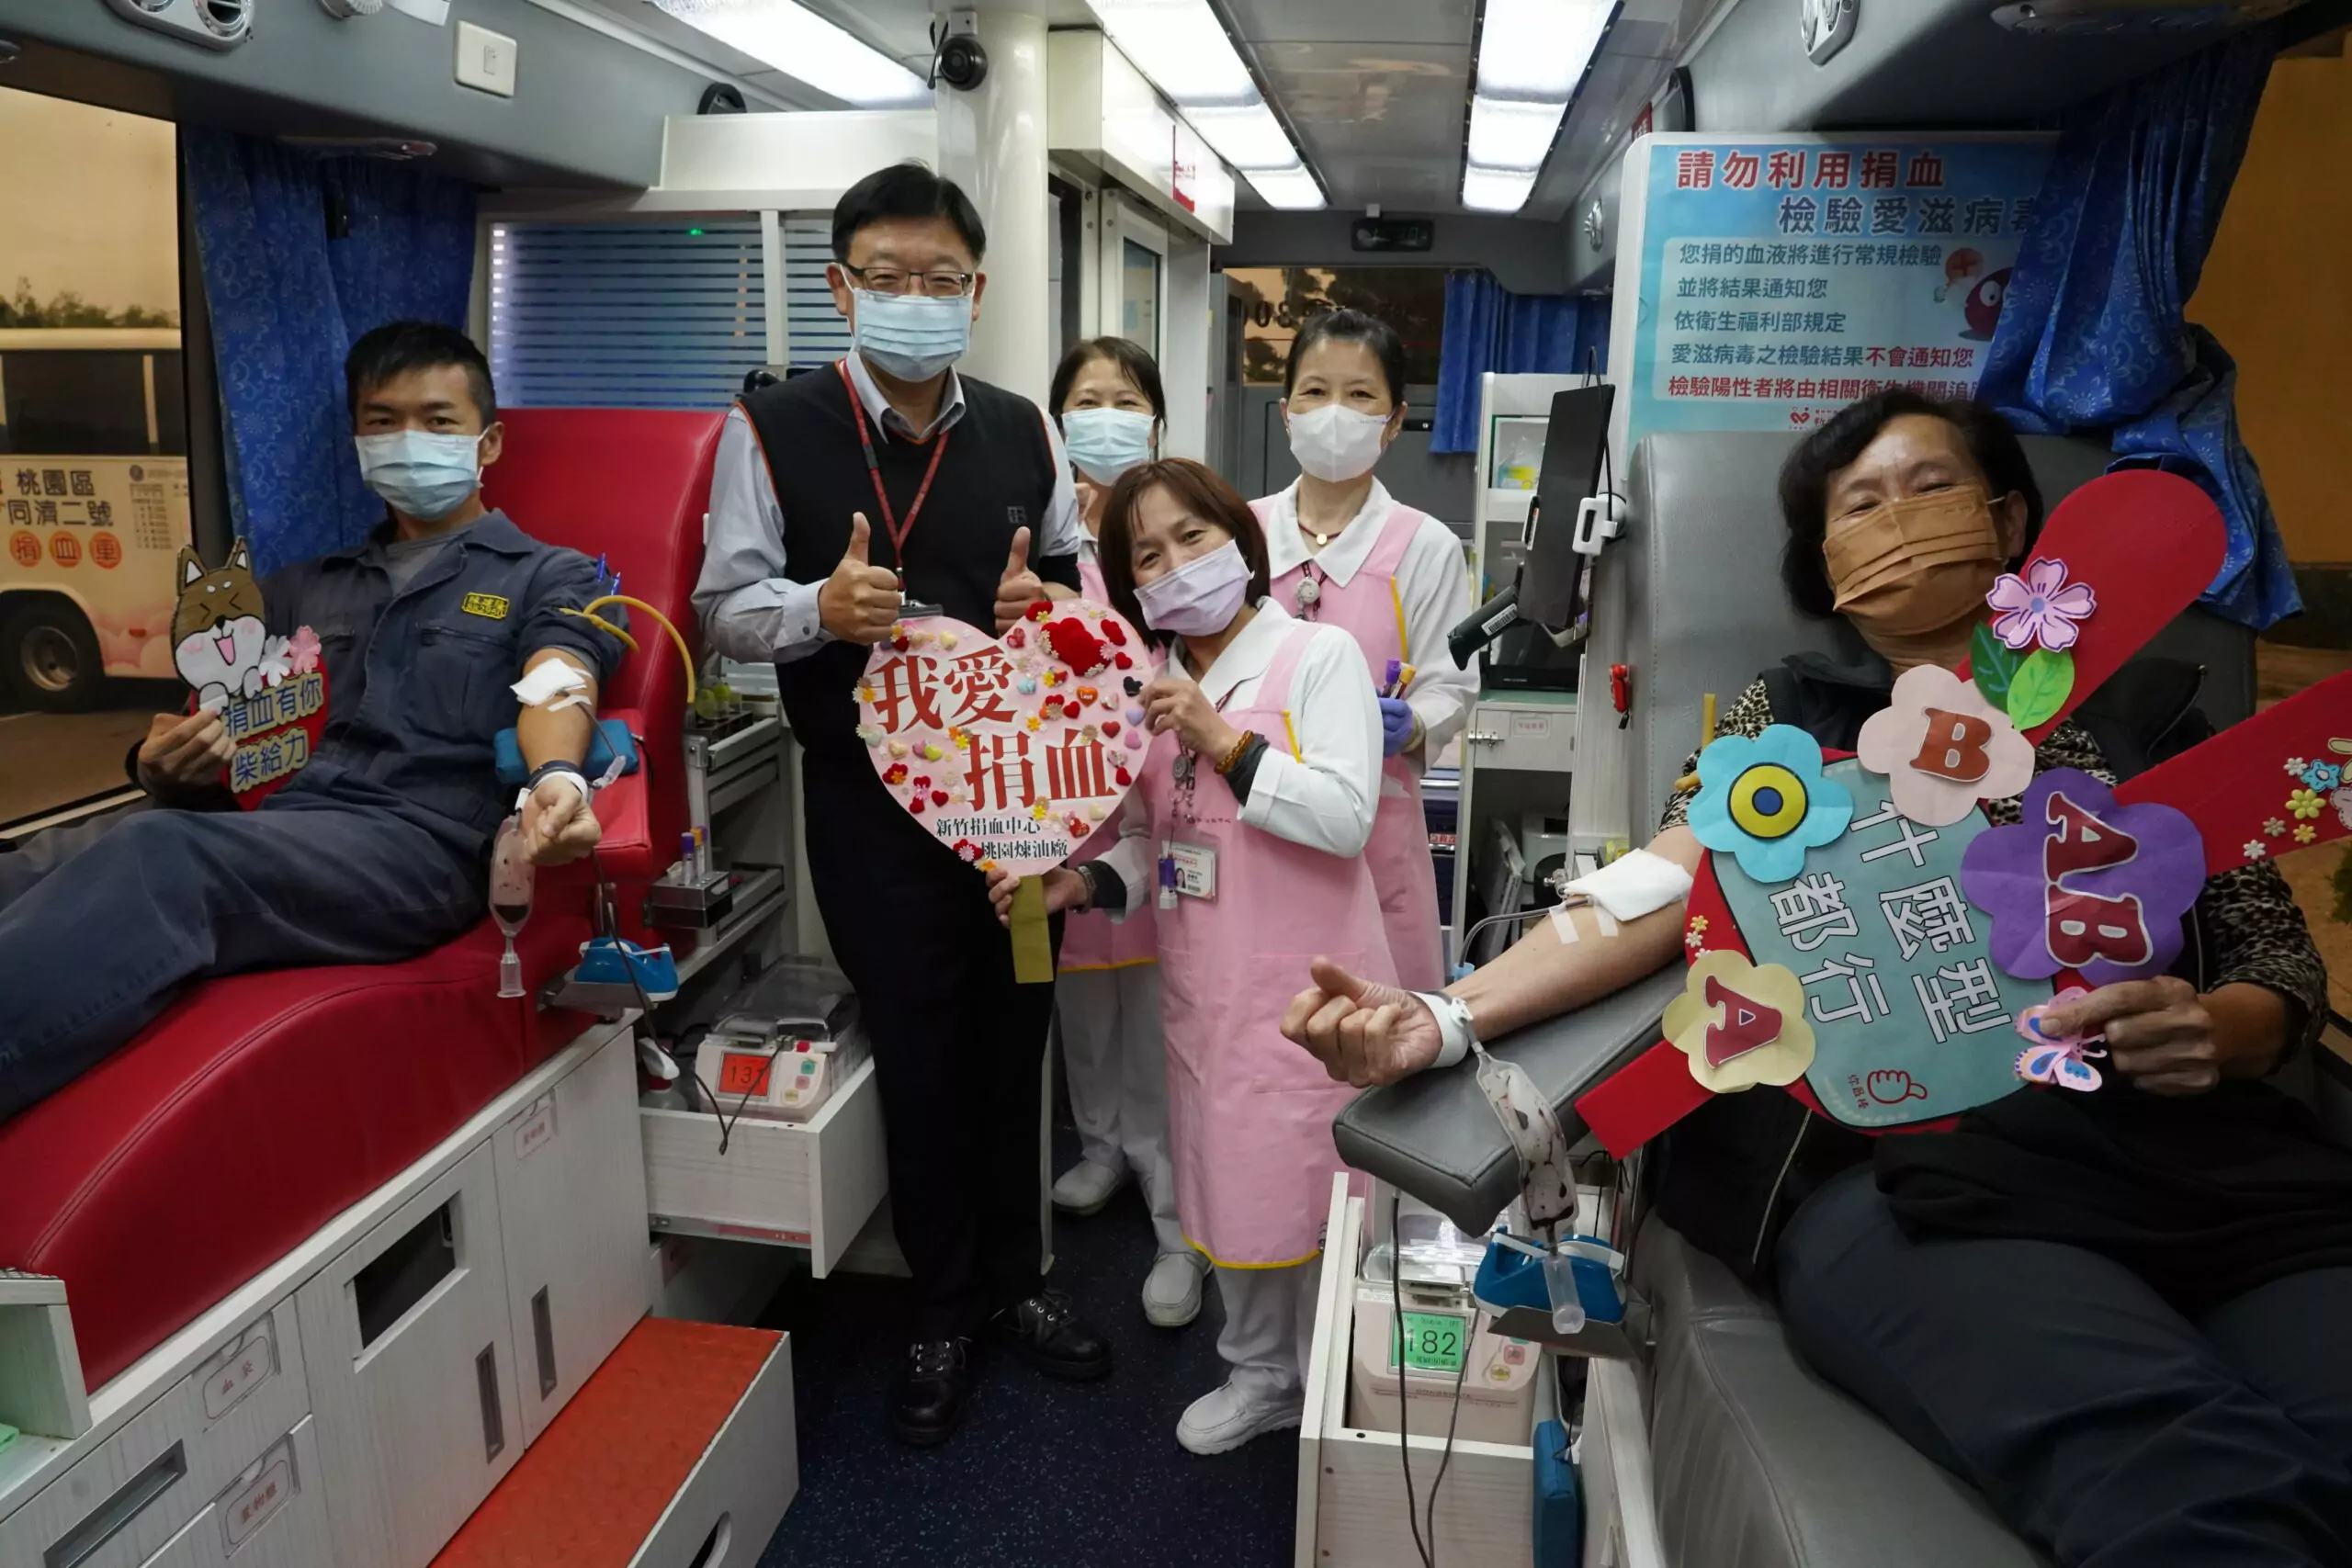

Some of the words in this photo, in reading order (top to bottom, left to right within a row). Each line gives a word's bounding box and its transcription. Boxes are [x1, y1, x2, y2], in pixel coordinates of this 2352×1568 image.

[1678, 151, 1944, 189] 請勿利用捐血
[1679, 243, 1942, 266] 您捐的血液將進行常規檢驗
[1677, 277, 1828, 299] 並將結果通知您
[1674, 311, 1847, 333] 依衛生福利部規定
[1672, 343, 1973, 369] 愛滋病毒之檢驗結果不會通知您
[1668, 377, 1978, 401] 檢驗陽性者將由相關衛機關追
[16, 468, 95, 496] 桃園區
[225, 678, 322, 738] 捐血有你
[870, 645, 1018, 734] 我愛
[235, 733, 307, 787] 柴給力
[1910, 706, 1993, 784] B
[962, 728, 1119, 813] 捐血
[936, 816, 1041, 837] 新竹捐血中心
[980, 838, 1069, 860] 桃園煉油廠
[2042, 790, 2154, 967] AB
[1849, 800, 2012, 1044] 什麼型
[1769, 873, 1891, 1024] 都行
[1703, 974, 1783, 1071] A
[1407, 1328, 1456, 1357] 182
